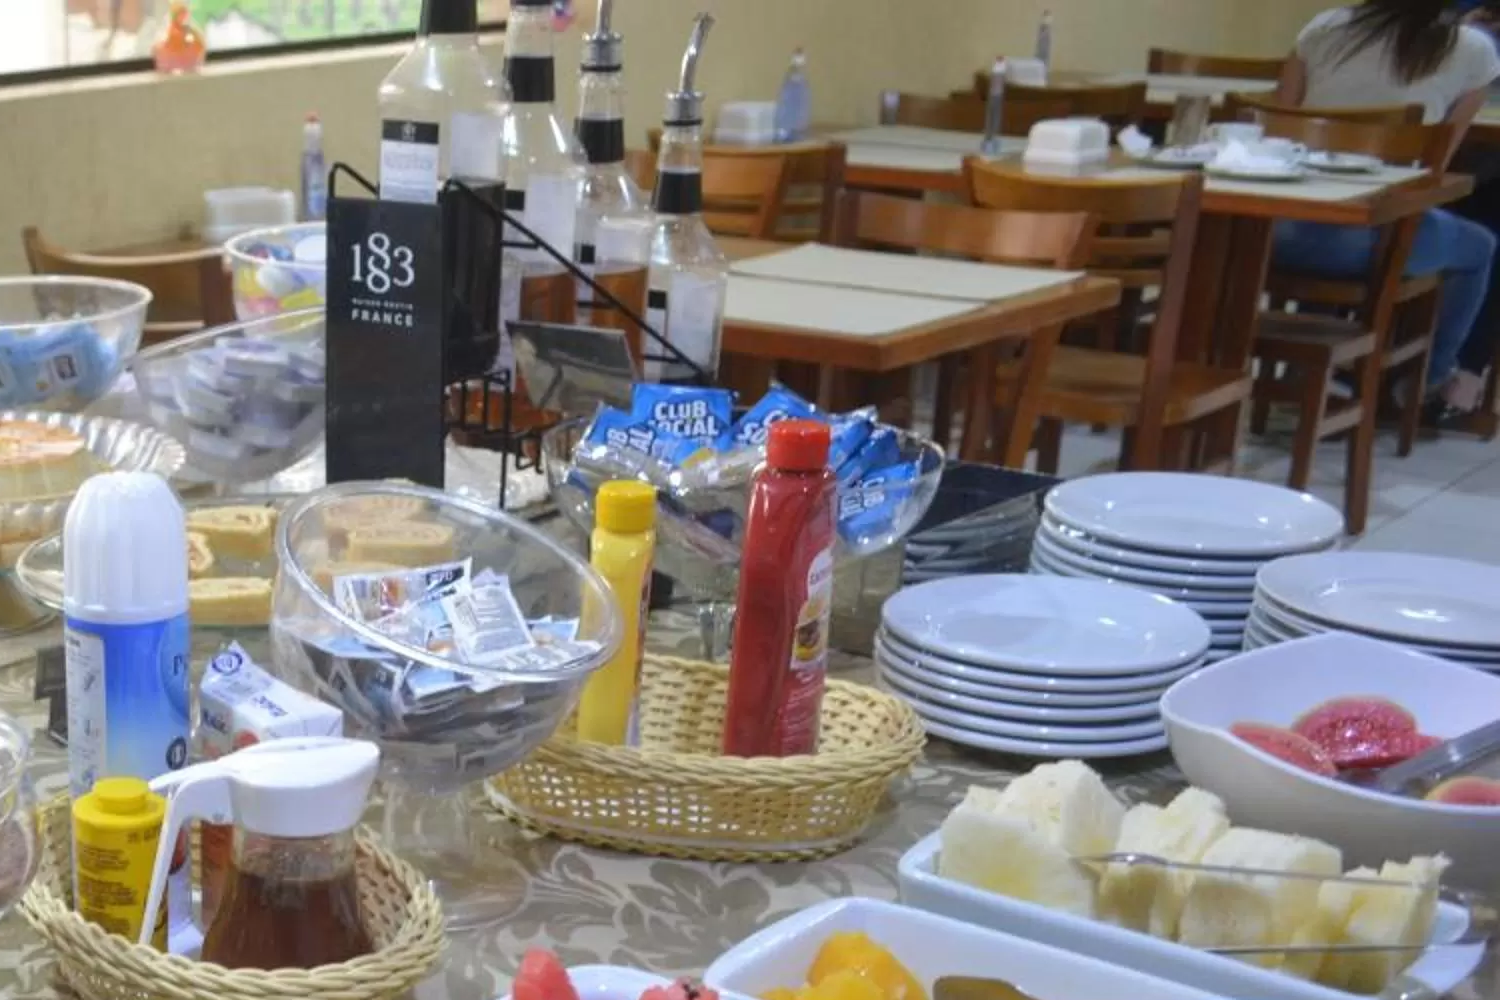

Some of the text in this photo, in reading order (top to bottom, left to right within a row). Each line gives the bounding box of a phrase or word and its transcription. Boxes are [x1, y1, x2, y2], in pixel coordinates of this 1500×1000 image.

[351, 308, 414, 328] FRANCE
[654, 400, 707, 421] CLUB
[648, 416, 719, 438] OCIAL
